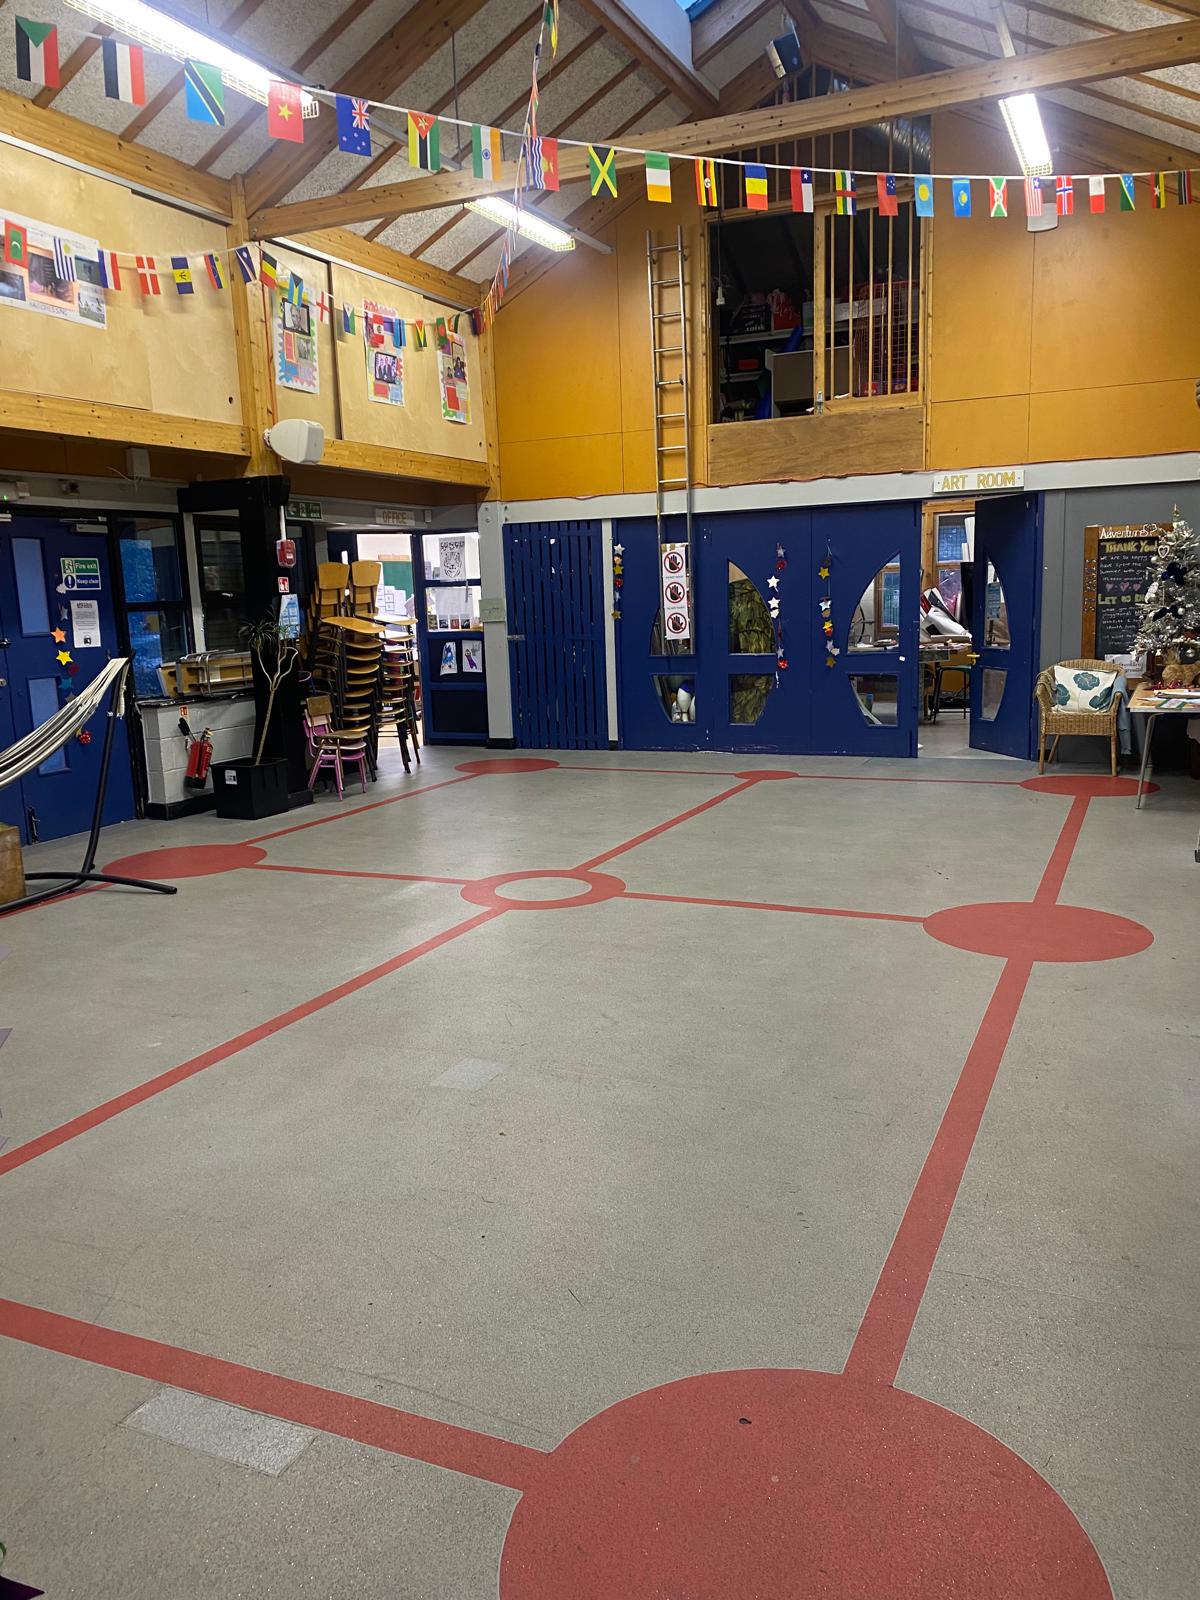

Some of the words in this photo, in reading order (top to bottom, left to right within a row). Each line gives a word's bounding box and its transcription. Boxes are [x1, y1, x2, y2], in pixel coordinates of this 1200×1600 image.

[941, 475, 969, 491] ART
[976, 471, 1016, 489] ROOM
[382, 510, 408, 524] OFFICE
[1104, 541, 1139, 553] THANK
